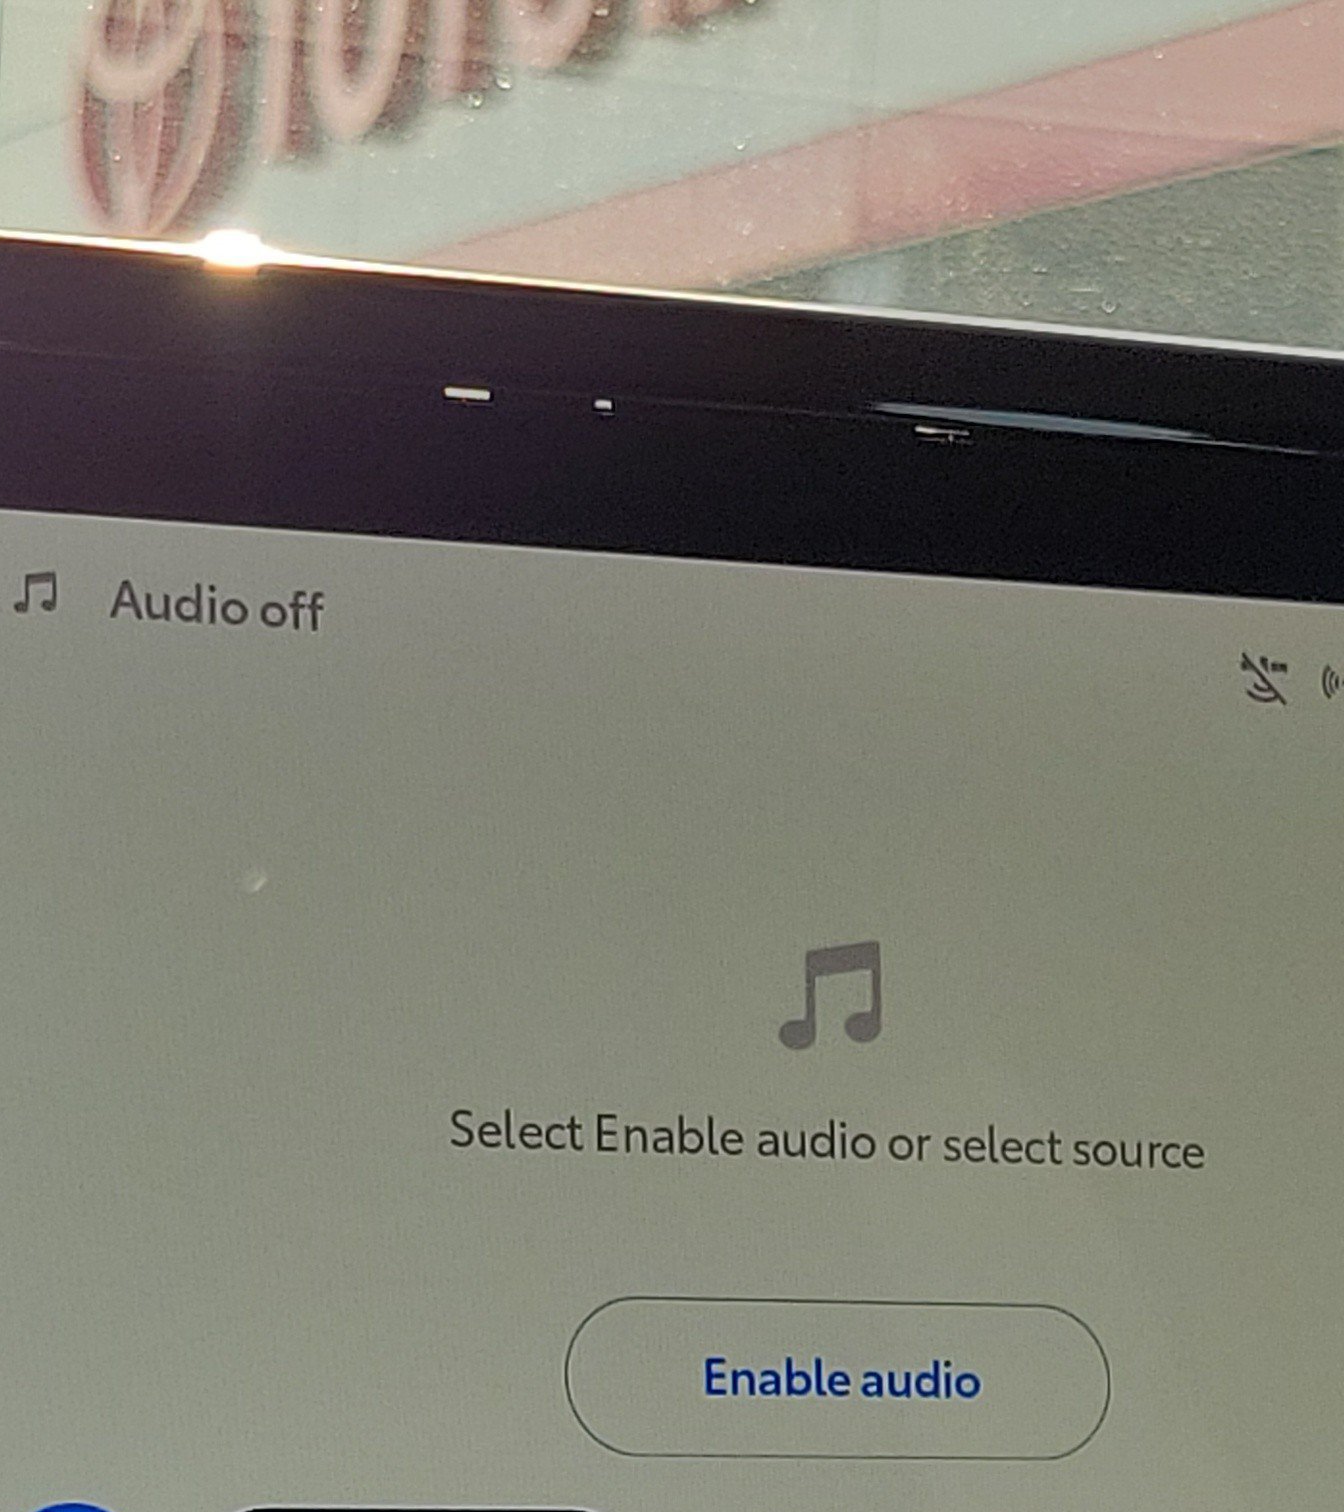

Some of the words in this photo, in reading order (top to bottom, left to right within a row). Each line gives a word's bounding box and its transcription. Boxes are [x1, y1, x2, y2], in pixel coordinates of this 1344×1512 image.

[109, 579, 249, 626] Audio
[260, 590, 325, 632] off
[450, 1108, 584, 1152] Select
[596, 1113, 744, 1156] Enable
[757, 1118, 877, 1160] audio
[888, 1134, 932, 1162] or
[943, 1124, 1063, 1166] select
[1073, 1140, 1205, 1170] source
[705, 1356, 851, 1397] Enable
[860, 1359, 981, 1399] audio
